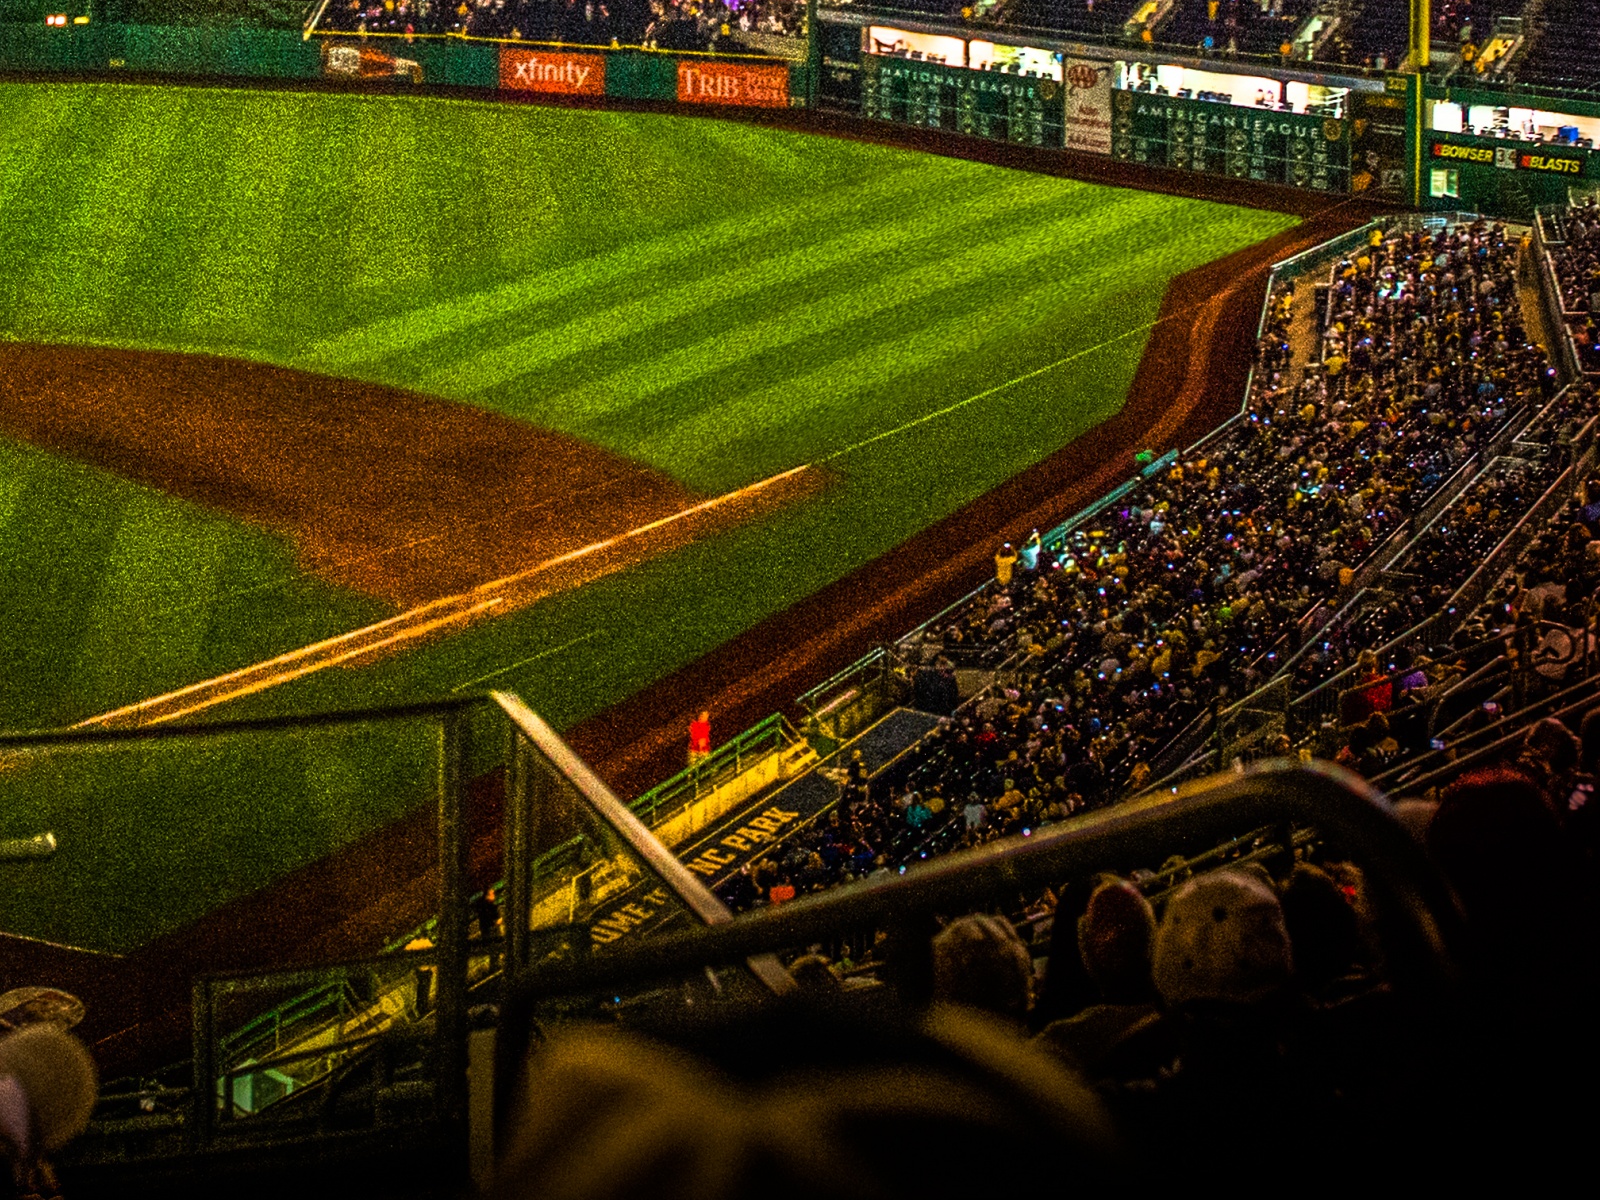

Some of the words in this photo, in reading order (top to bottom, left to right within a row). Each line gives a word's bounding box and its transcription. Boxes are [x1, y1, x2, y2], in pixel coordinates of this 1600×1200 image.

[515, 57, 591, 89] xfinity
[678, 68, 740, 98] TRIB
[880, 65, 964, 88] NATIONAL
[968, 78, 1035, 100] LEAGUE
[1136, 103, 1237, 128] AMERICAN
[1243, 117, 1321, 140] LEAGUE
[1440, 144, 1494, 163] BOWSER
[1529, 155, 1581, 174] BLASTS
[685, 846, 737, 877] NC
[720, 806, 800, 851] PARK
